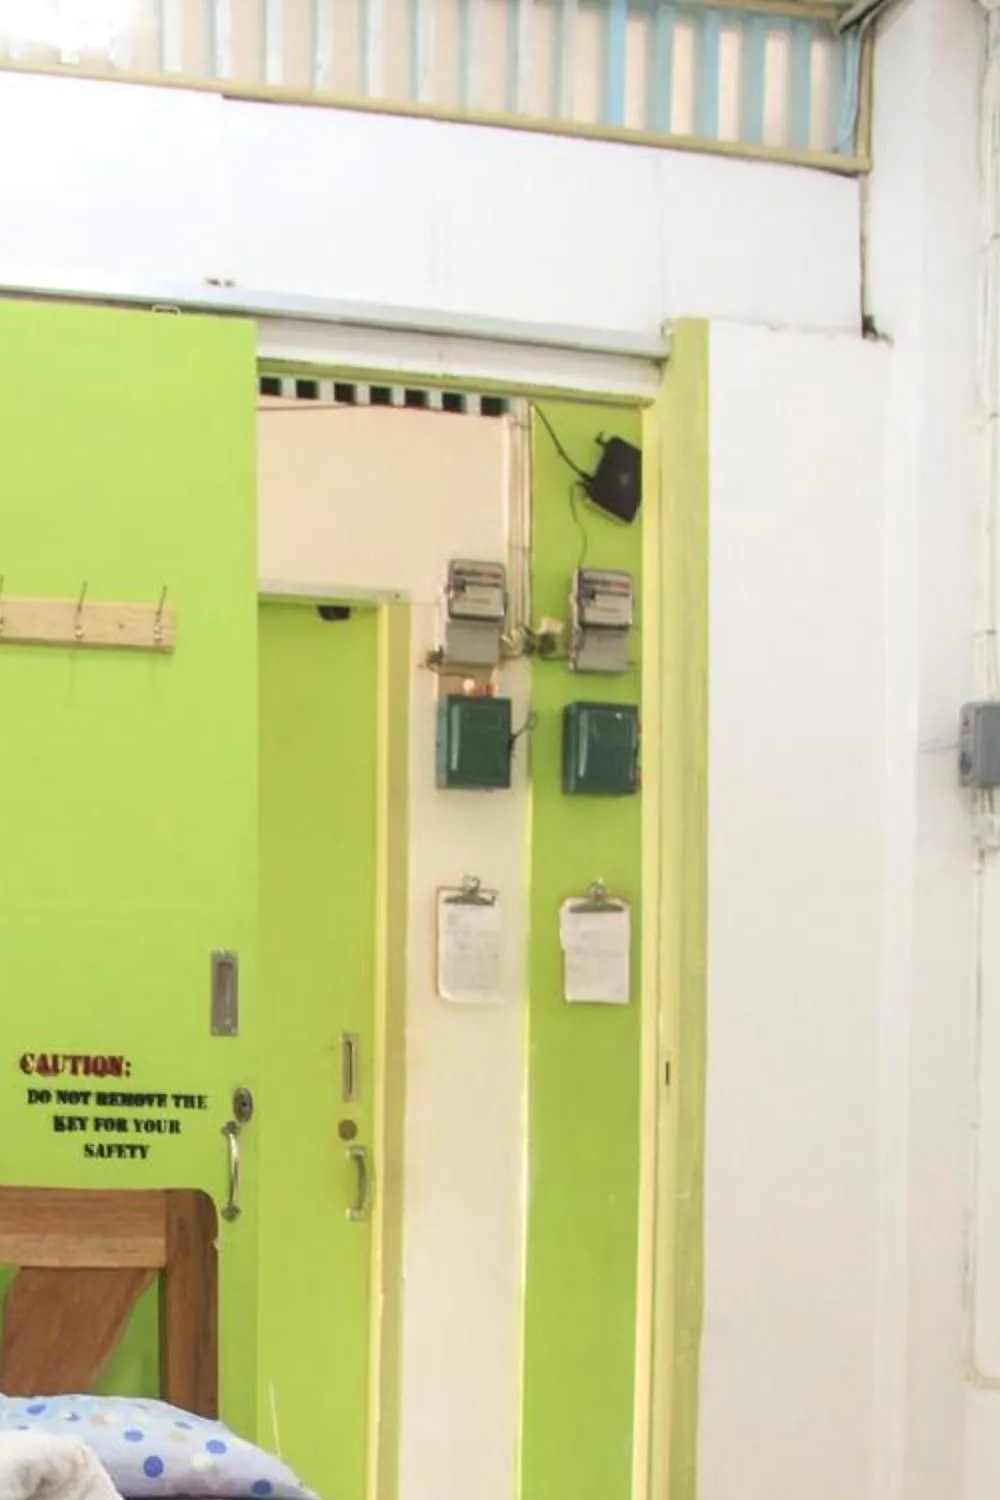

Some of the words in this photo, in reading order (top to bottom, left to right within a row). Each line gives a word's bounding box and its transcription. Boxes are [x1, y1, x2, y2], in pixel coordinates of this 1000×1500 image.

[19, 1053, 131, 1077] CAUTION:
[27, 1089, 52, 1104] DO
[56, 1090, 91, 1105] NOT
[96, 1091, 168, 1107] REMOVE
[172, 1094, 208, 1109] THE
[53, 1115, 89, 1132] KEY
[94, 1117, 128, 1132] FOR
[133, 1119, 181, 1134] YOUR
[84, 1143, 149, 1159] SAFETY
